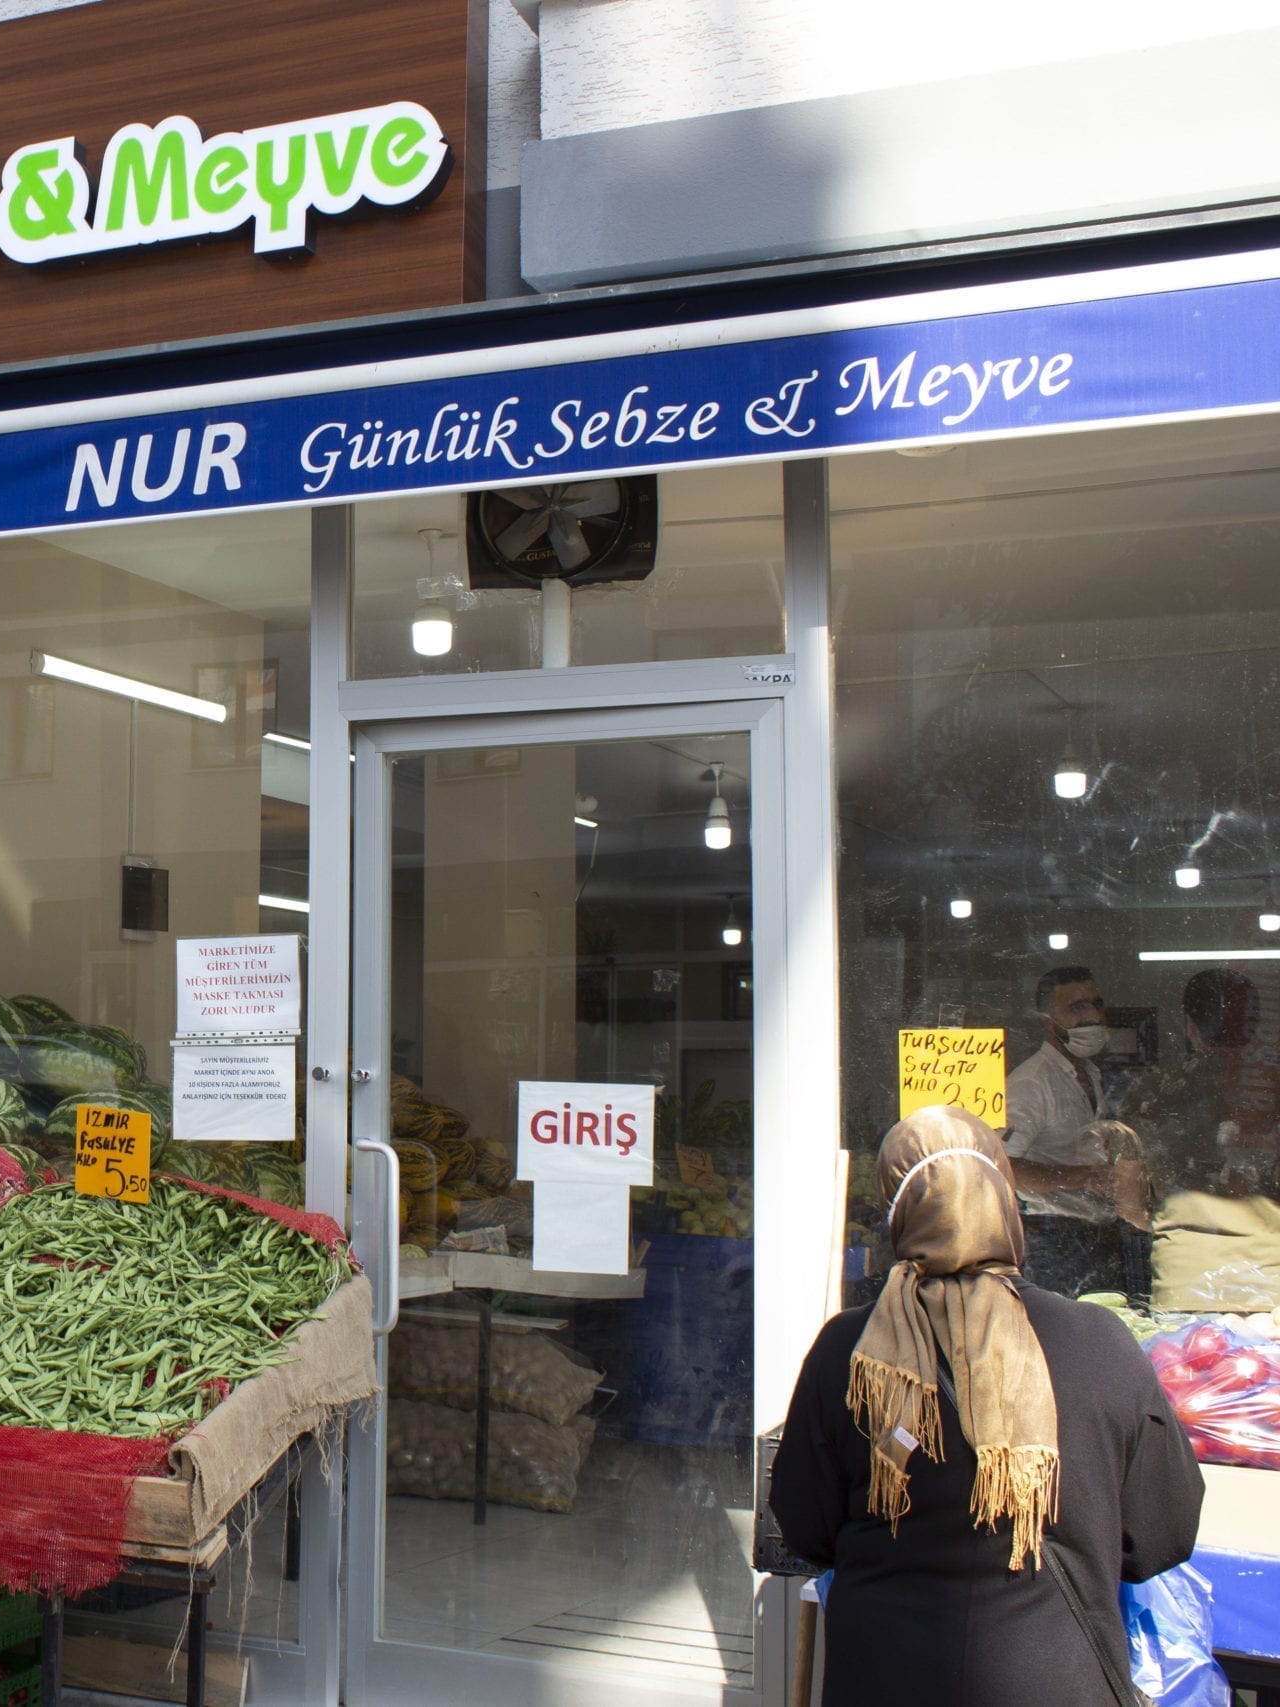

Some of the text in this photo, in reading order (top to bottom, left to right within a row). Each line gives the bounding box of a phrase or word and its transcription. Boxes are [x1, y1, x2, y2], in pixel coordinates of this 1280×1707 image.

[7, 149, 76, 241] &
[106, 117, 429, 232] Meyve
[64, 349, 1074, 512] NUR Günlük Sebze & Meyve
[198, 943, 276, 957] MARKETİMİZE
[206, 958, 267, 971] GİREN TÜM
[185, 972, 291, 988] MÜŞTERİLERİMİZİN
[193, 990, 284, 1001] MASKE TAKMASI
[200, 1004, 276, 1016] ZORUNLUDUR
[902, 1032, 1004, 1060] TURŞULUK
[530, 1102, 638, 1156] GİRİŞ
